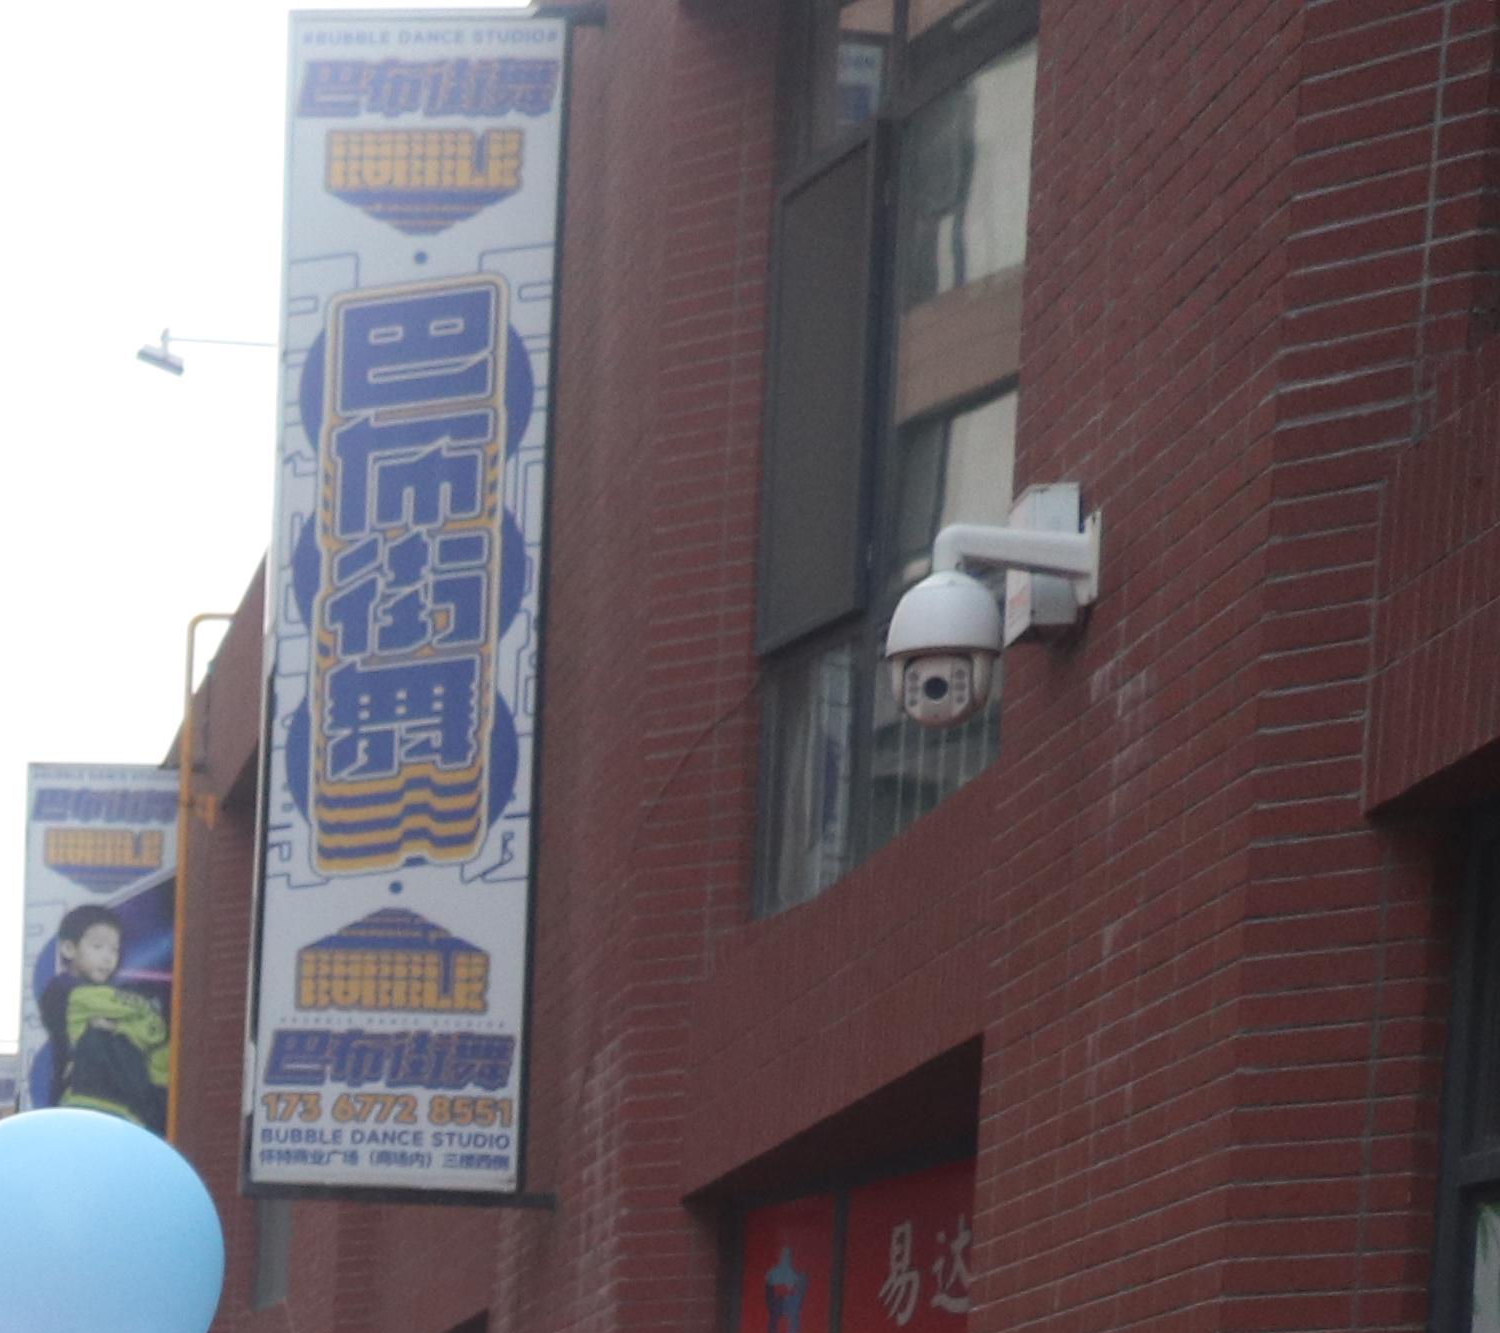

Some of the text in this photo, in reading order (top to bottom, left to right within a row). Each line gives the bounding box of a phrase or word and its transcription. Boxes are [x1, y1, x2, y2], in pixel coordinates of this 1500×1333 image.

[399, 30, 466, 45] DANCE
[297, 56, 561, 119] 巴布街舞
[325, 286, 498, 784] 巴布街舞
[263, 1028, 517, 1090] 巴布街舞
[261, 1092, 513, 1128] 173 6772 8551
[260, 1128, 511, 1150] BUBBLE DANCE STUDIO
